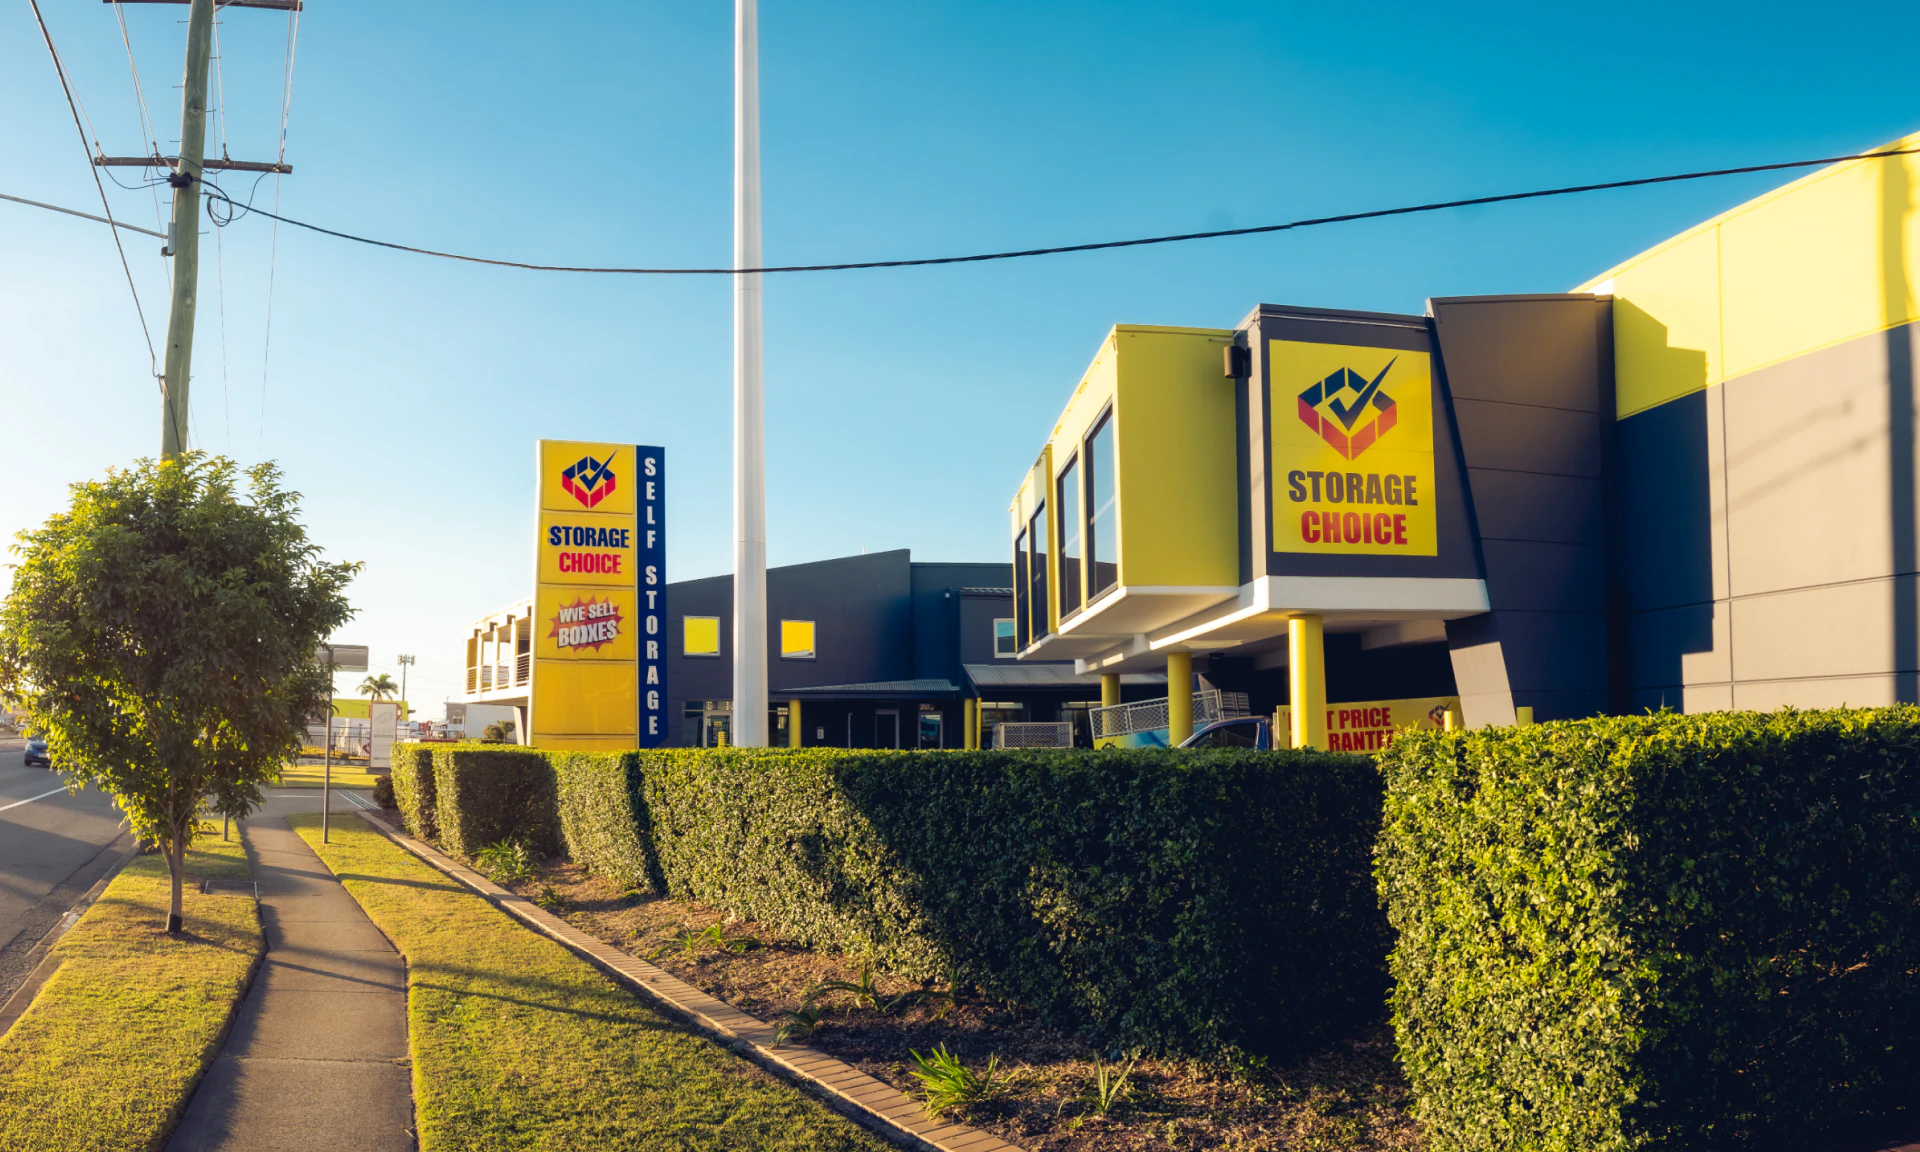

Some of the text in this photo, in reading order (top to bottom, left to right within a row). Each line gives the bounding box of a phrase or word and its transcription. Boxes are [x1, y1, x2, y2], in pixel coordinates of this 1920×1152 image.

[1287, 469, 1418, 506] STORAGE
[548, 525, 630, 549] STORAGE
[1301, 510, 1408, 545] CHOICE
[558, 552, 622, 575] CHOICE
[644, 457, 659, 735] SELF STORAGE
[588, 601, 616, 619] SELL
[1339, 707, 1391, 729] PRICE
